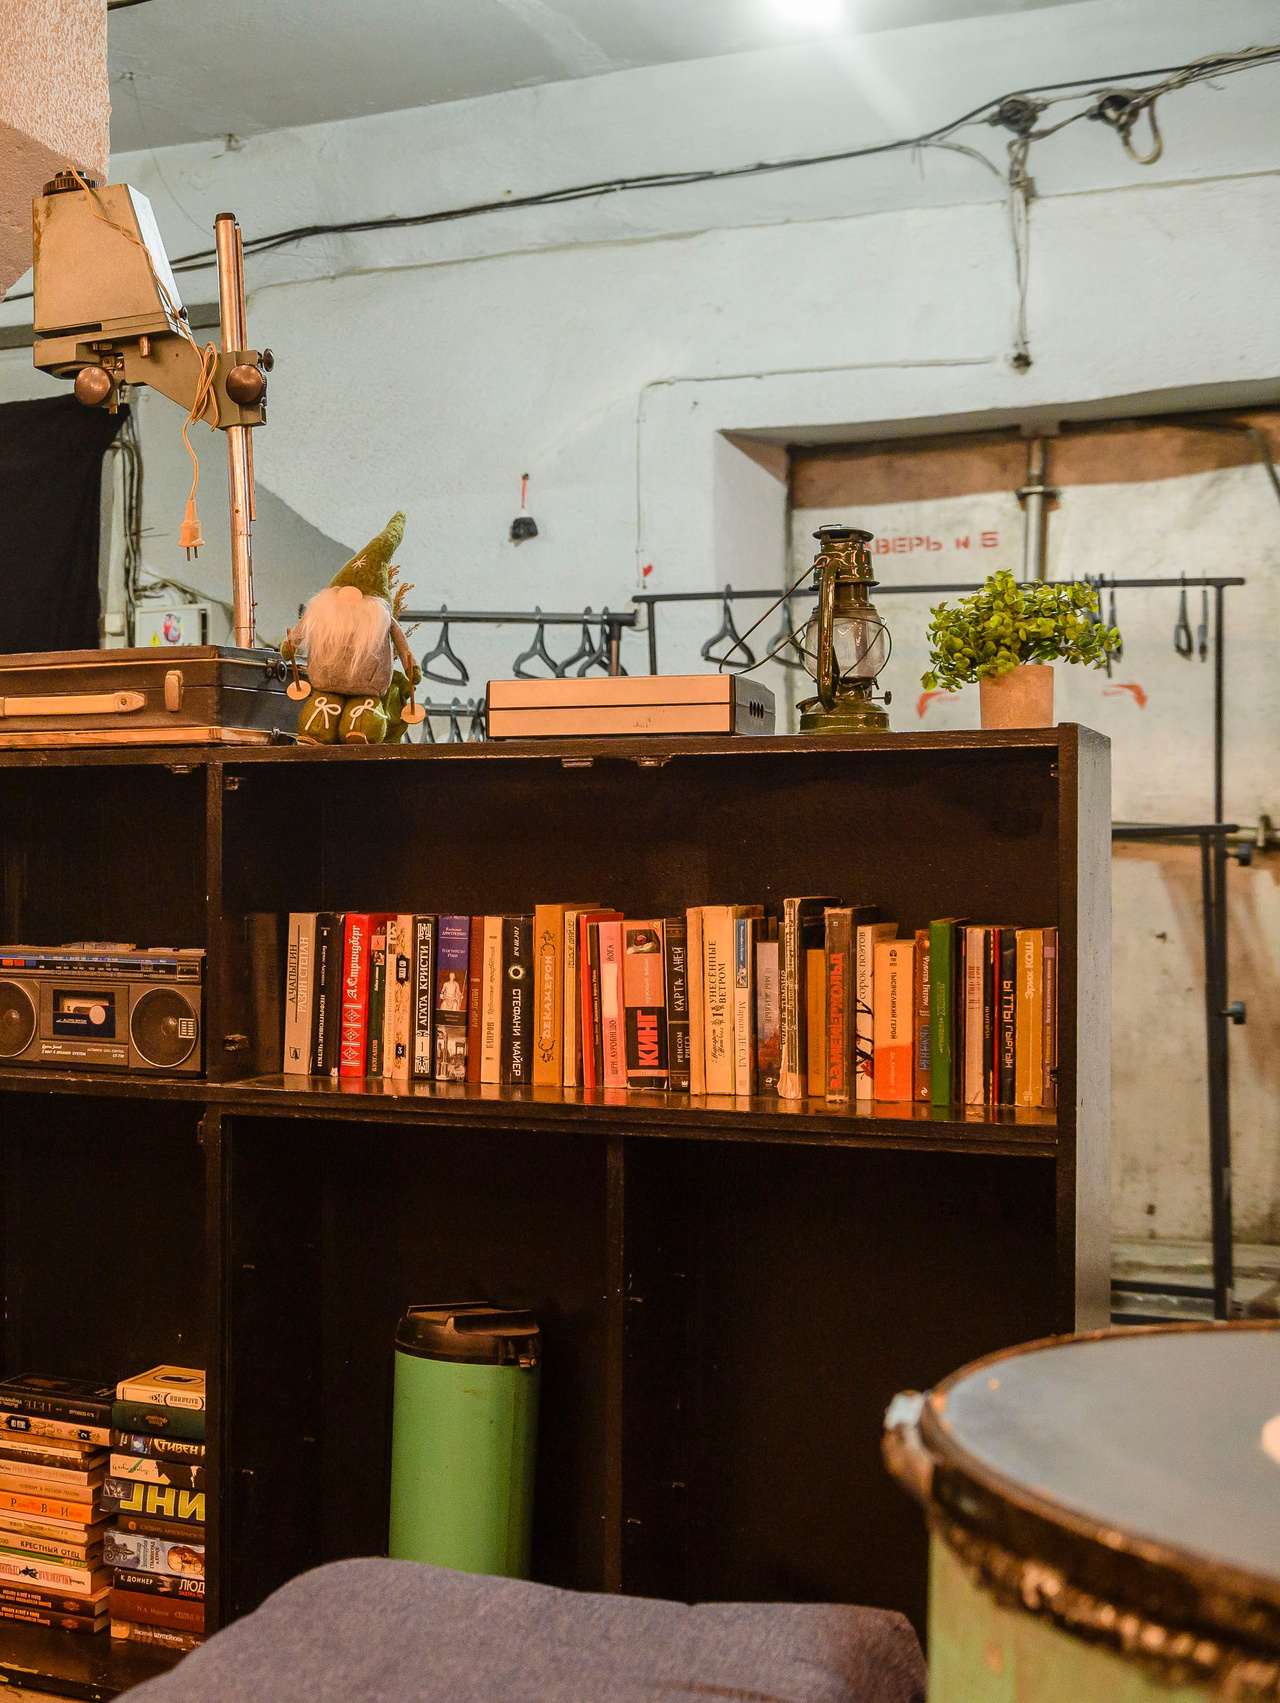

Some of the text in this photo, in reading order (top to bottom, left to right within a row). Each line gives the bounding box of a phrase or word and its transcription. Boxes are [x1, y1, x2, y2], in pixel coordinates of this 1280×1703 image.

[287, 943, 298, 1004] А.ЧАПЫГИН
[298, 936, 309, 1013] РАЗИН СТЕПАН
[345, 925, 363, 1001] А.Стриндберг
[606, 944, 615, 962] ЙОГА
[671, 946, 685, 1012] КАРТА ДНЕЙ
[707, 940, 718, 1004] УНЕСЁННЫЕ
[717, 962, 727, 1004] ВЕТРОМ
[858, 931, 869, 999] сорок поэтов
[1024, 941, 1035, 1000] Эрих КОШ
[418, 944, 429, 1026] АГАТА КРИСТИ
[542, 955, 552, 1040] ДЕКАМЕРОН
[764, 975, 772, 1024] МЫ ЖИВЫЕ
[890, 971, 898, 1040] ТЫСЯЧЕЛИКИЙ ГЕРОЙ
[397, 1045, 404, 1055] 3
[512, 988, 522, 1077] СТЕФАНИ МАЙЕР
[636, 1009, 659, 1067] КИНГ
[737, 1000, 746, 1068] Маркиз ДЕ САД
[80, 1431, 88, 1439] 2
[20, 1540, 80, 1560] КРЕСТНЫЙ ОТЕЦ
[127, 1576, 153, 1586] ДОННЕР
